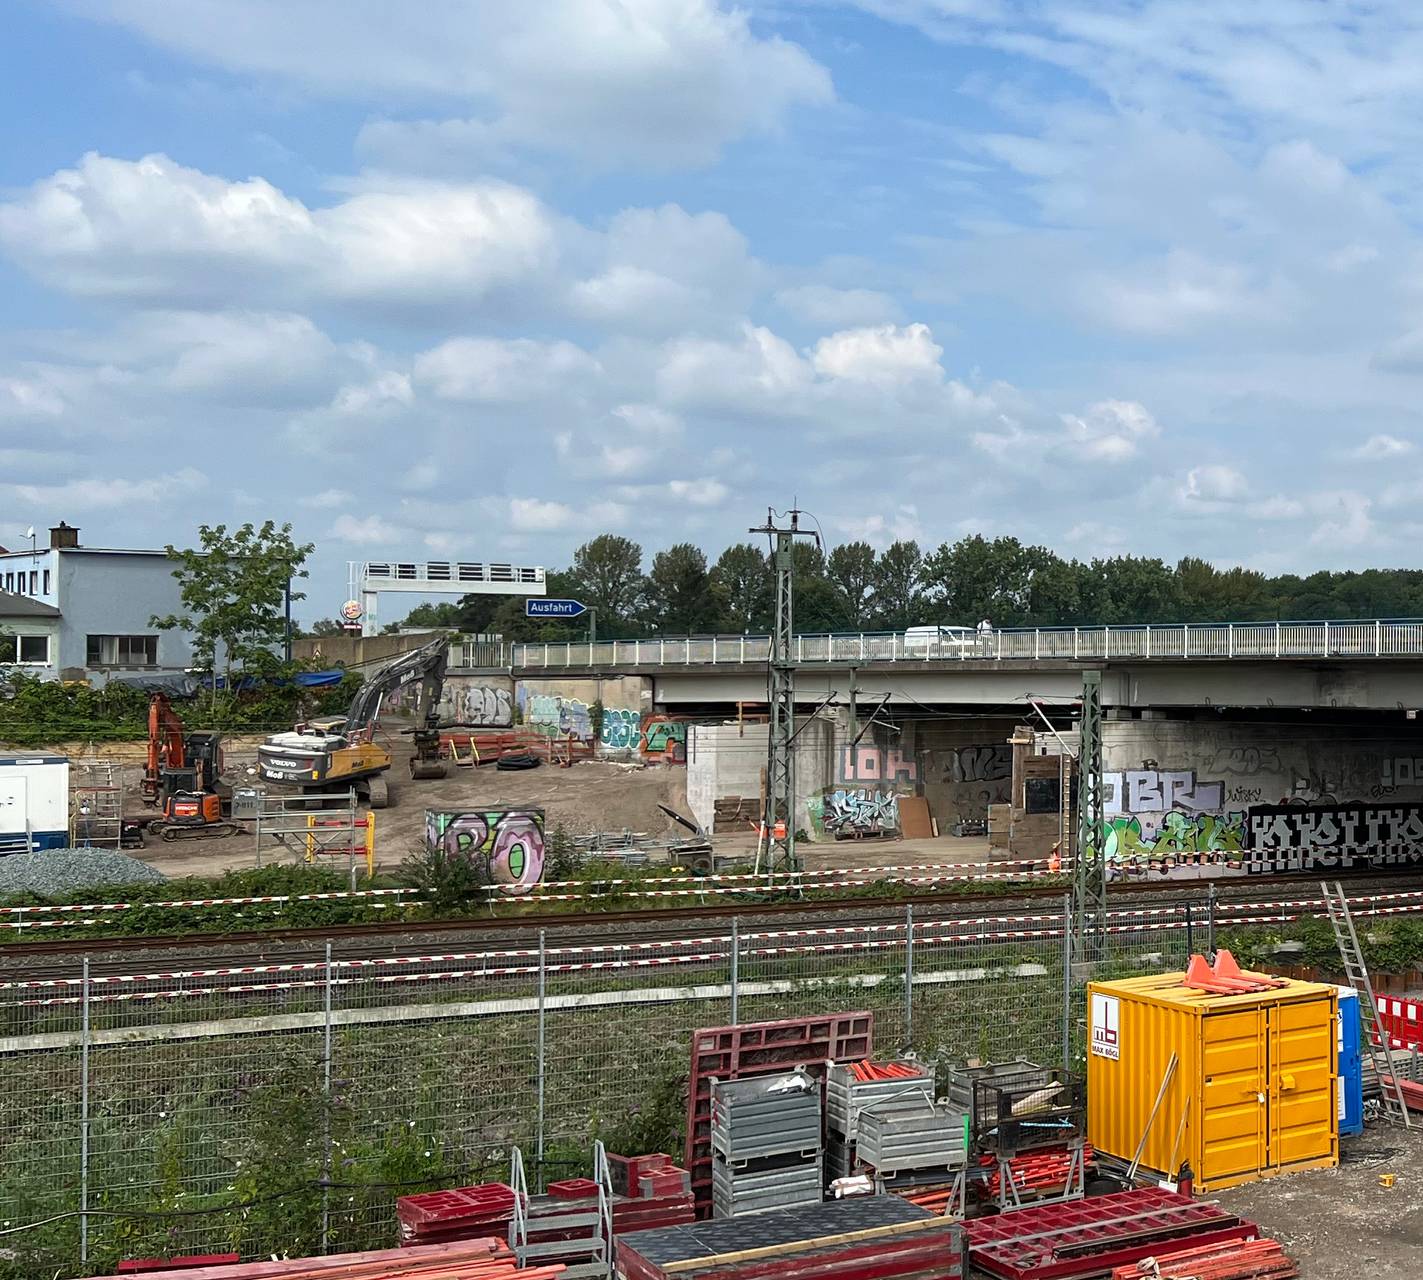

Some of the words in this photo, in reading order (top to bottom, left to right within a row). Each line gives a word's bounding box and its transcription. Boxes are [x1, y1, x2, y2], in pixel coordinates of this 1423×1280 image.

[530, 602, 573, 613] Ausfahrt
[269, 758, 297, 768] VOLVO
[1092, 1045, 1104, 1053] MAX
